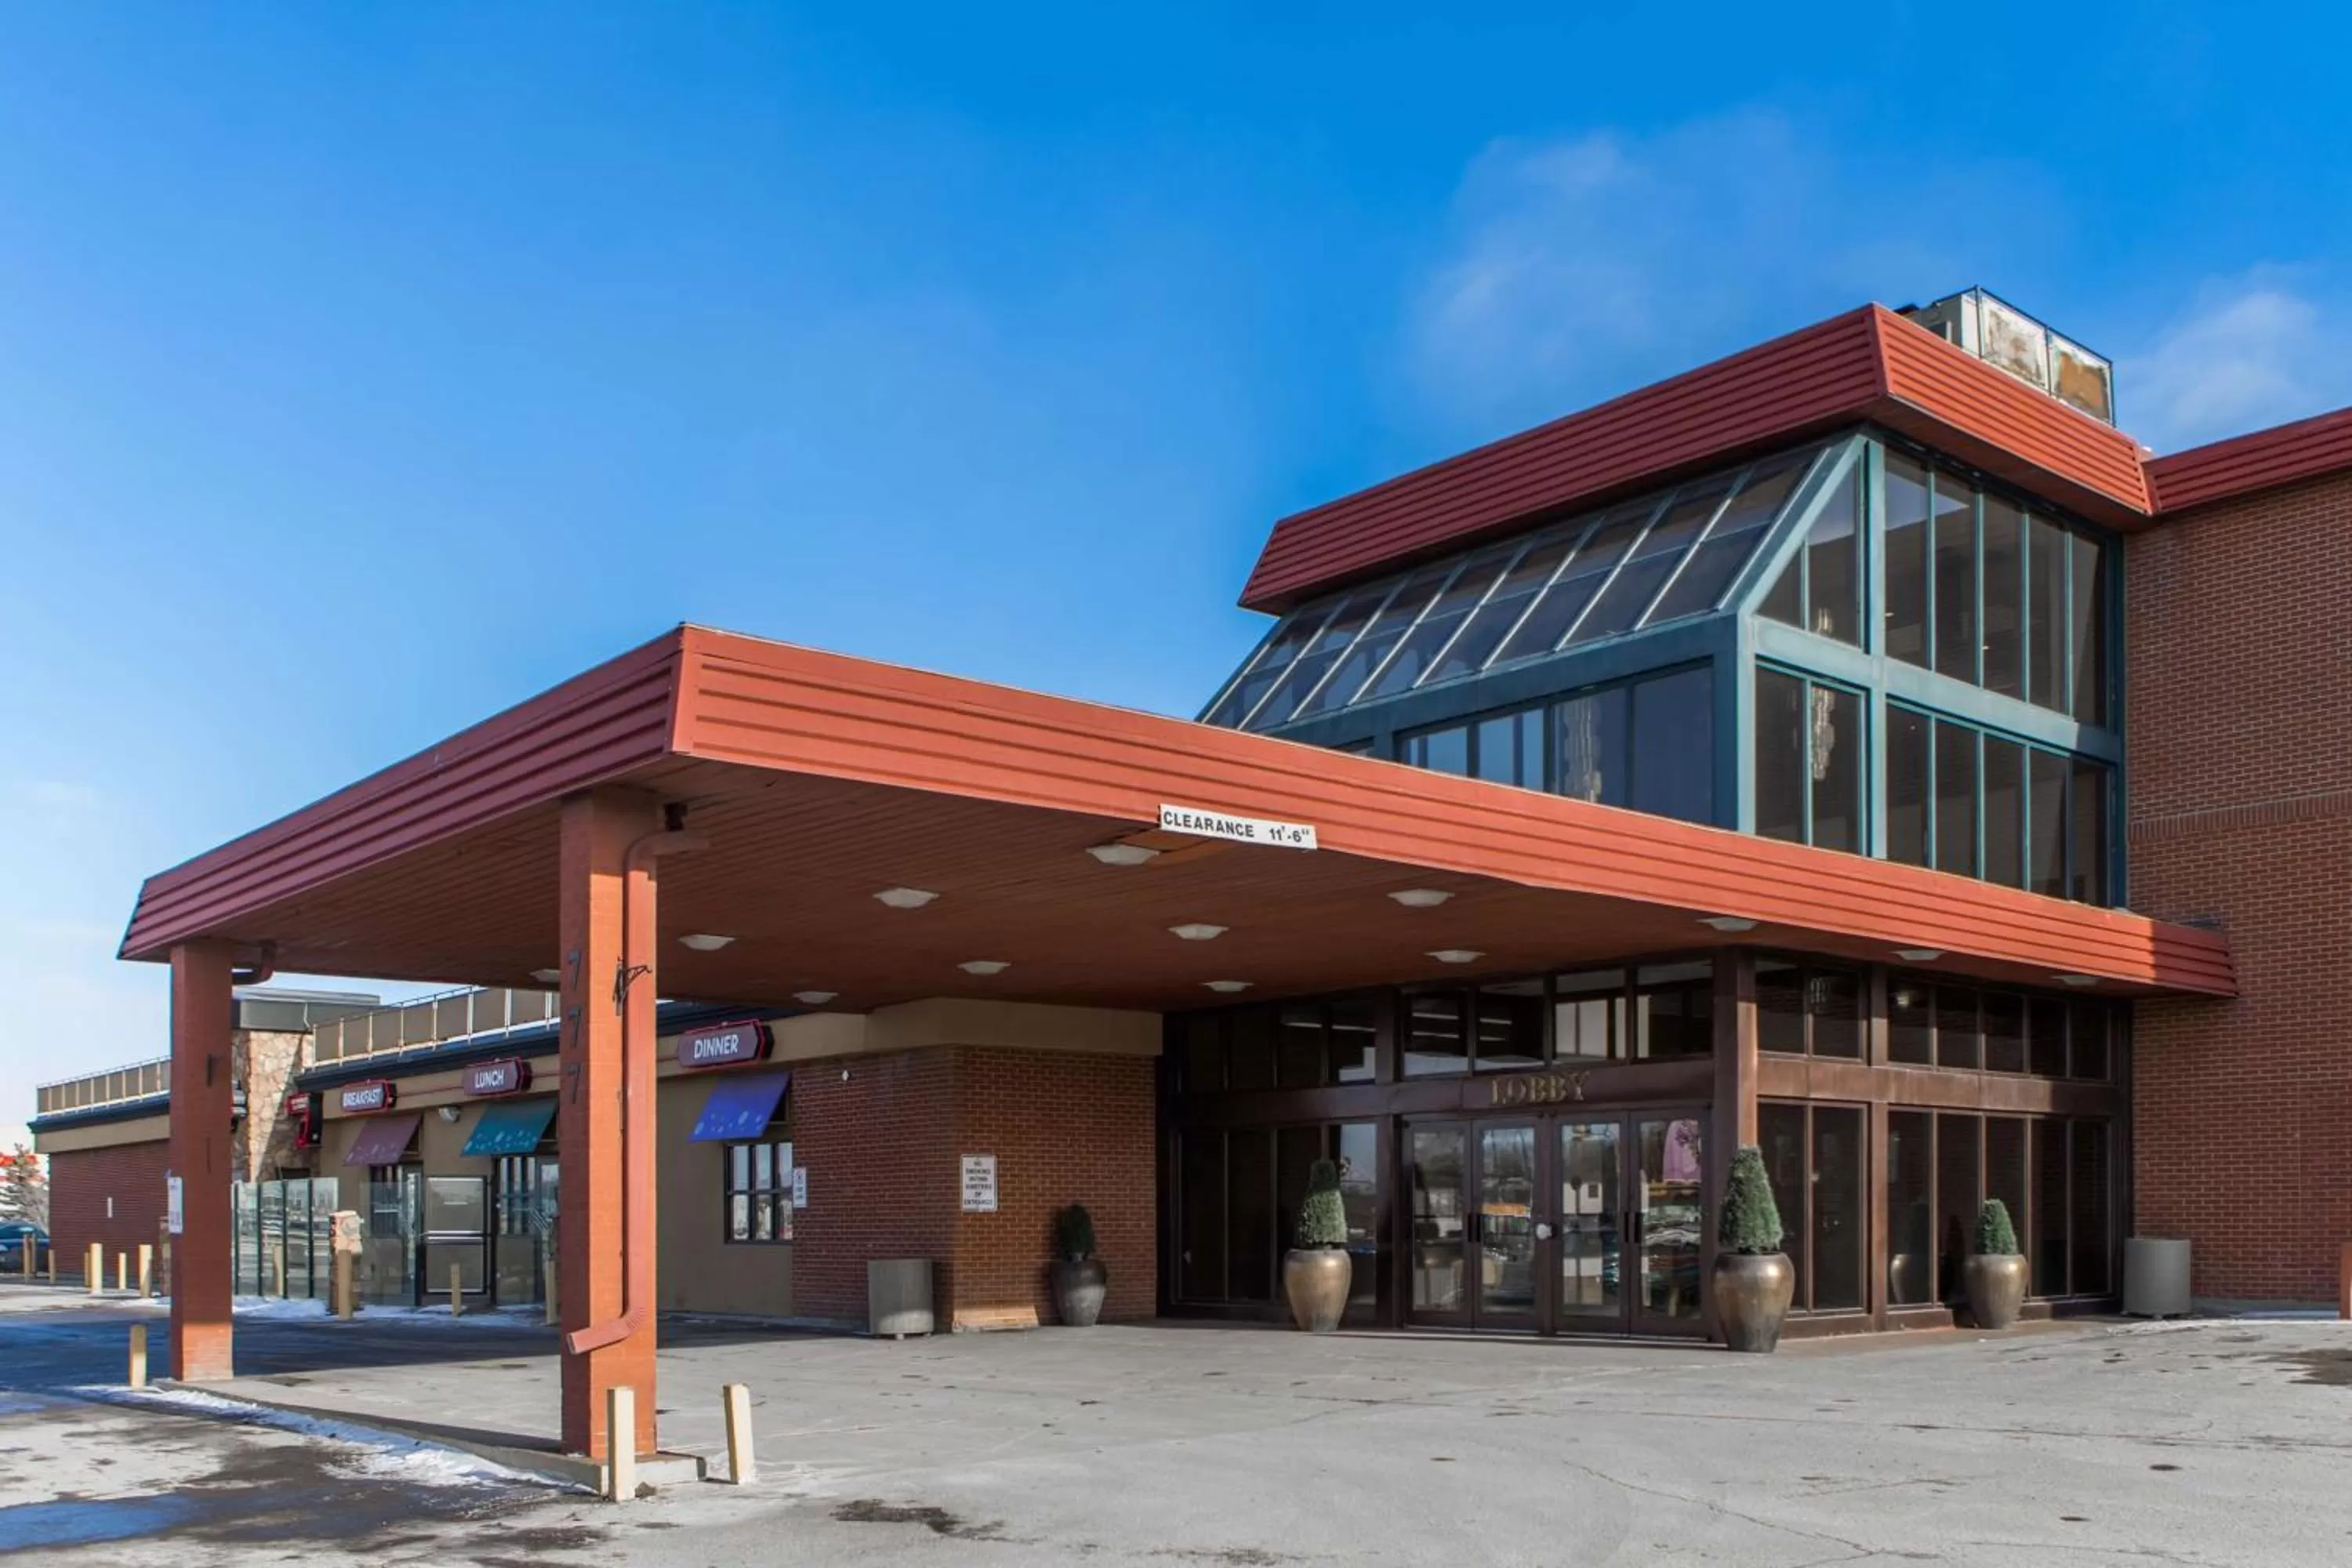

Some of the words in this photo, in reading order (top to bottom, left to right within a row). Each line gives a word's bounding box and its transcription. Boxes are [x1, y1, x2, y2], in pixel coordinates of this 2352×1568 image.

[1163, 811, 1254, 837] CLEARANCE
[694, 1034, 739, 1060] DINNER
[474, 1069, 504, 1089] LUNCH
[1491, 1070, 1591, 1105] LOBBY
[343, 1087, 382, 1107] BREAKFAST
